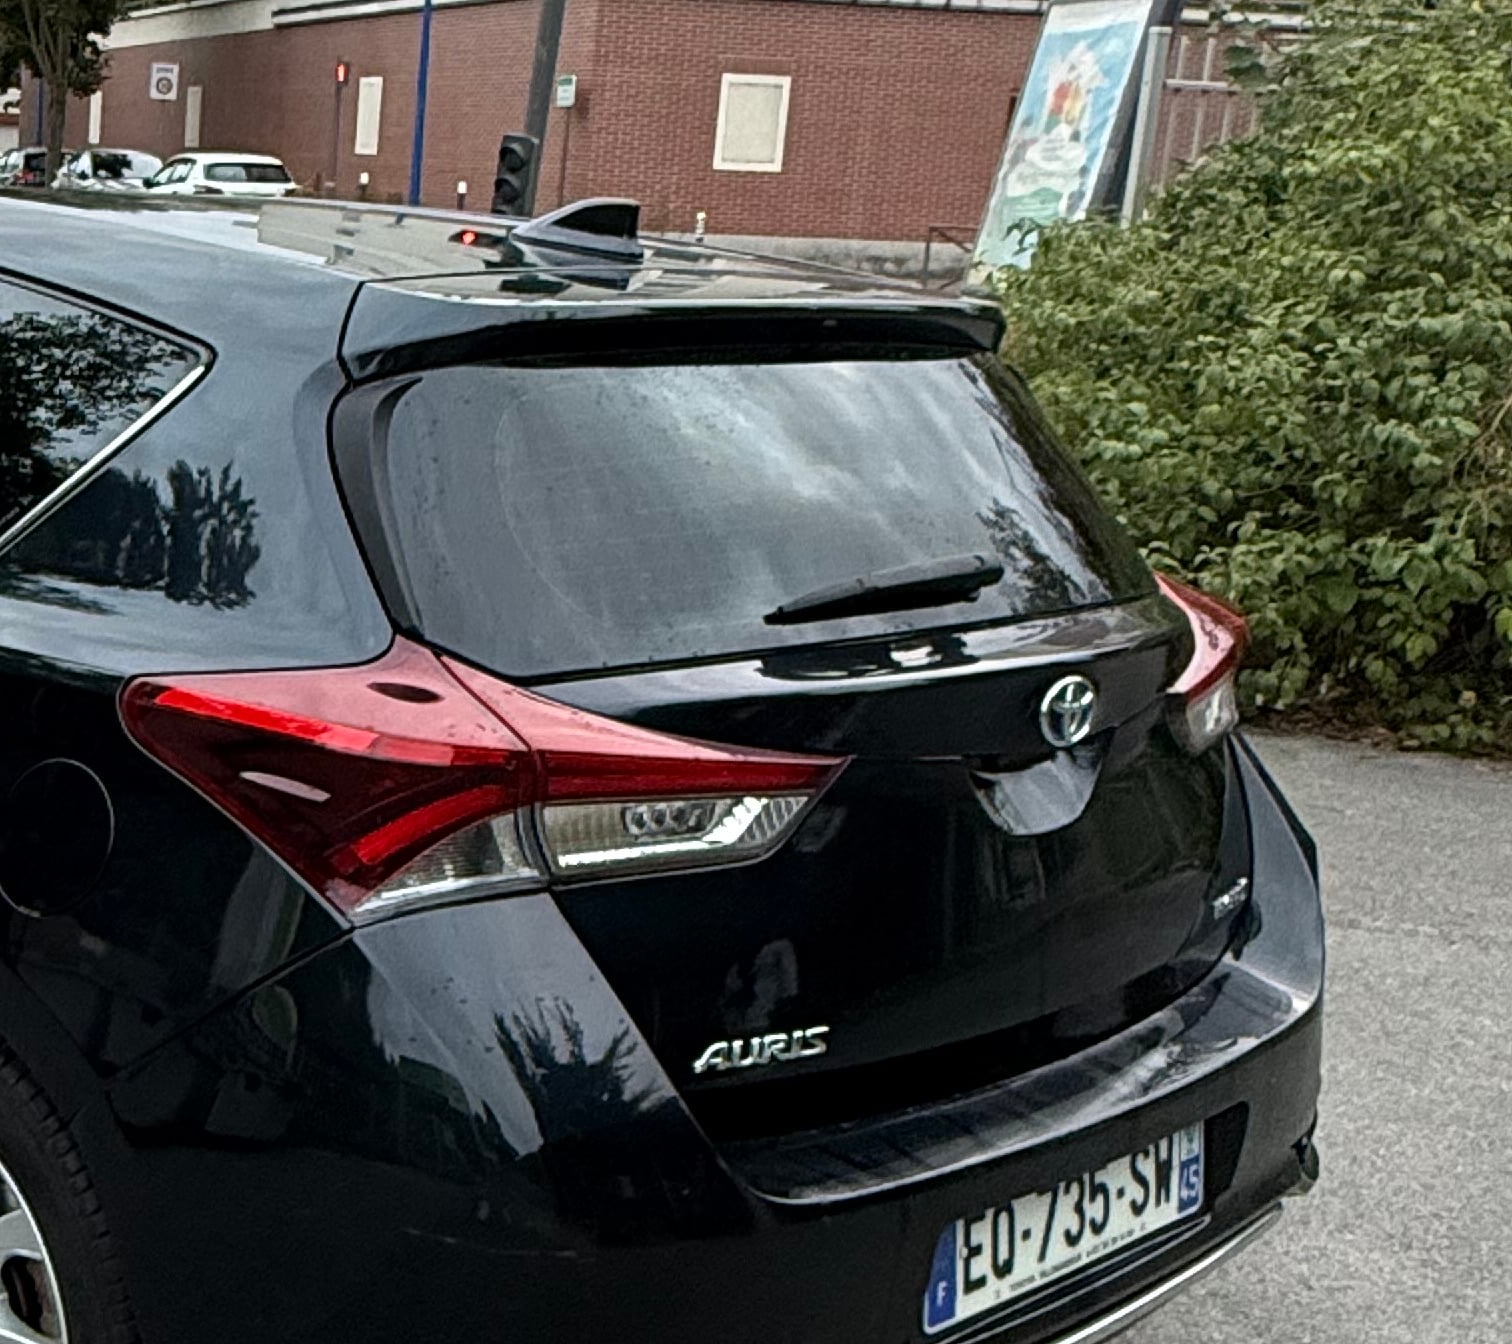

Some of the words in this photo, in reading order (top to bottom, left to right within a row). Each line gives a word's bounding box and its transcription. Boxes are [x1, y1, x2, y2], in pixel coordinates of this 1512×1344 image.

[693, 1025, 831, 1073] AURIS
[936, 1280, 948, 1308] F
[962, 1134, 1173, 1296] EQ-735-SW
[1180, 1163, 1200, 1202] 45
